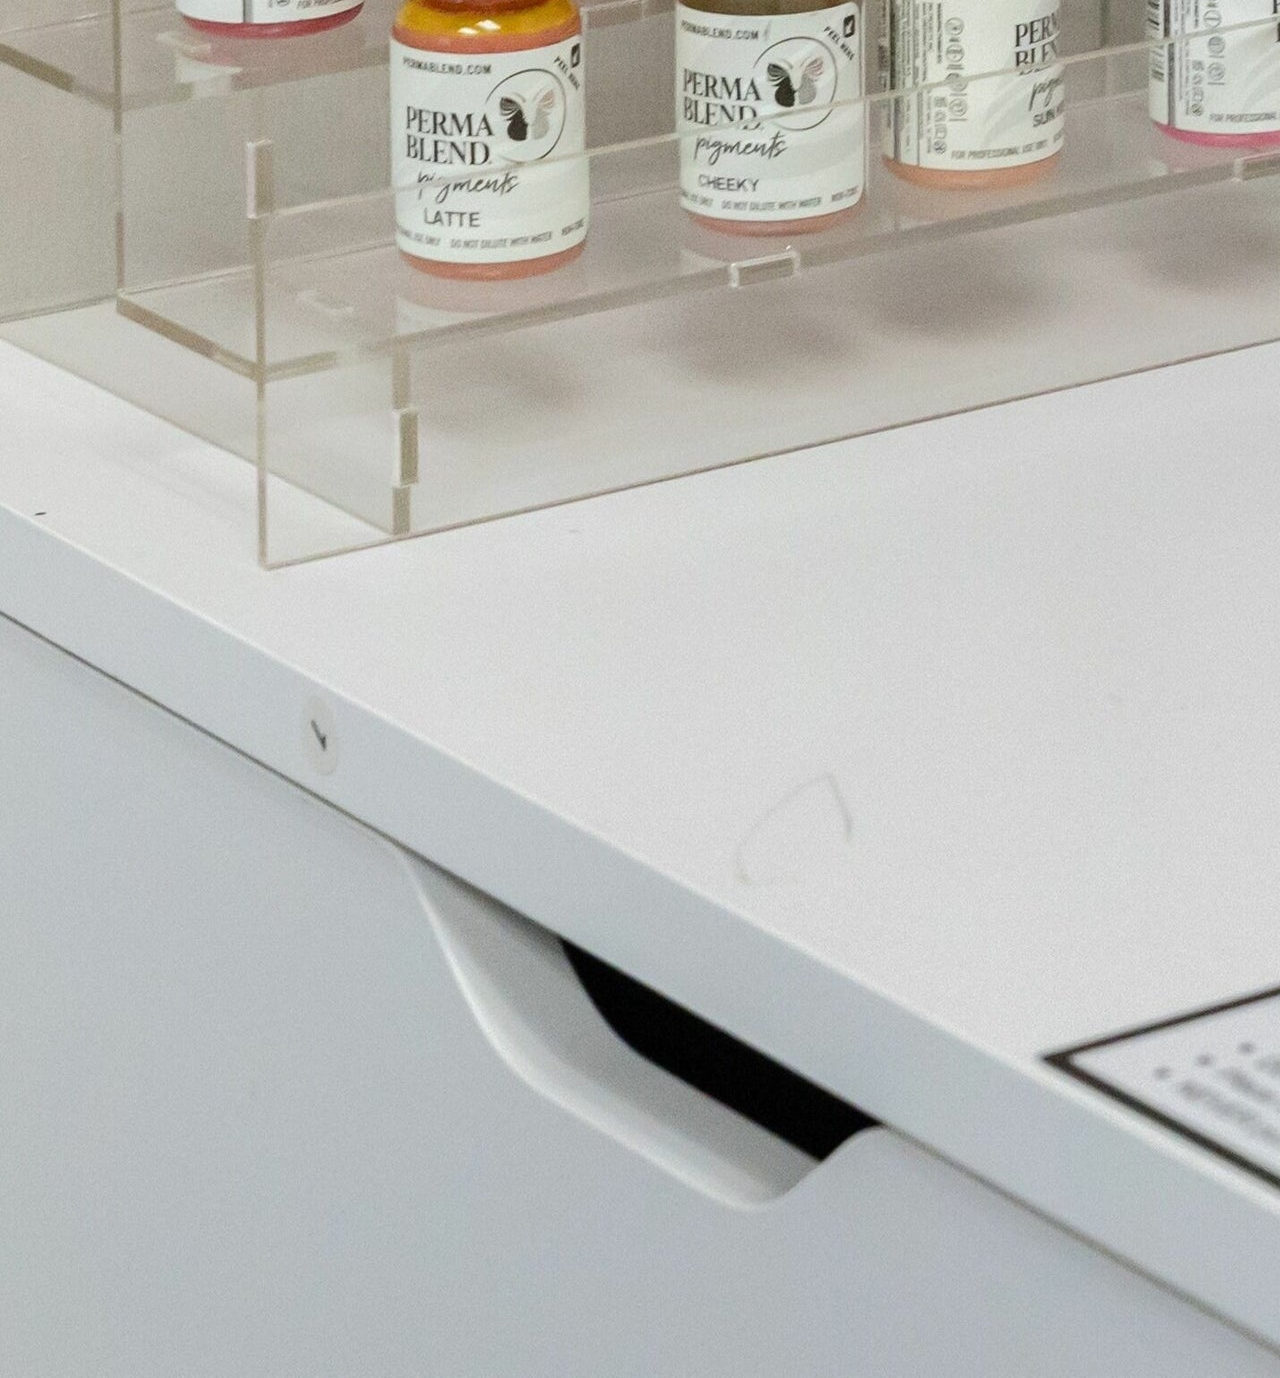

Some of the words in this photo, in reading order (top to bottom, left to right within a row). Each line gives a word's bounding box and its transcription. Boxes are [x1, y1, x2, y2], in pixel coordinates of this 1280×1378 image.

[1015, 13, 1059, 47] PER
[682, 67, 763, 102] PERMA
[405, 104, 495, 137] PERMA
[693, 130, 788, 166] pigments
[416, 170, 521, 205] pigments
[698, 172, 760, 193] CHEEKY
[423, 206, 482, 228] LATTE
